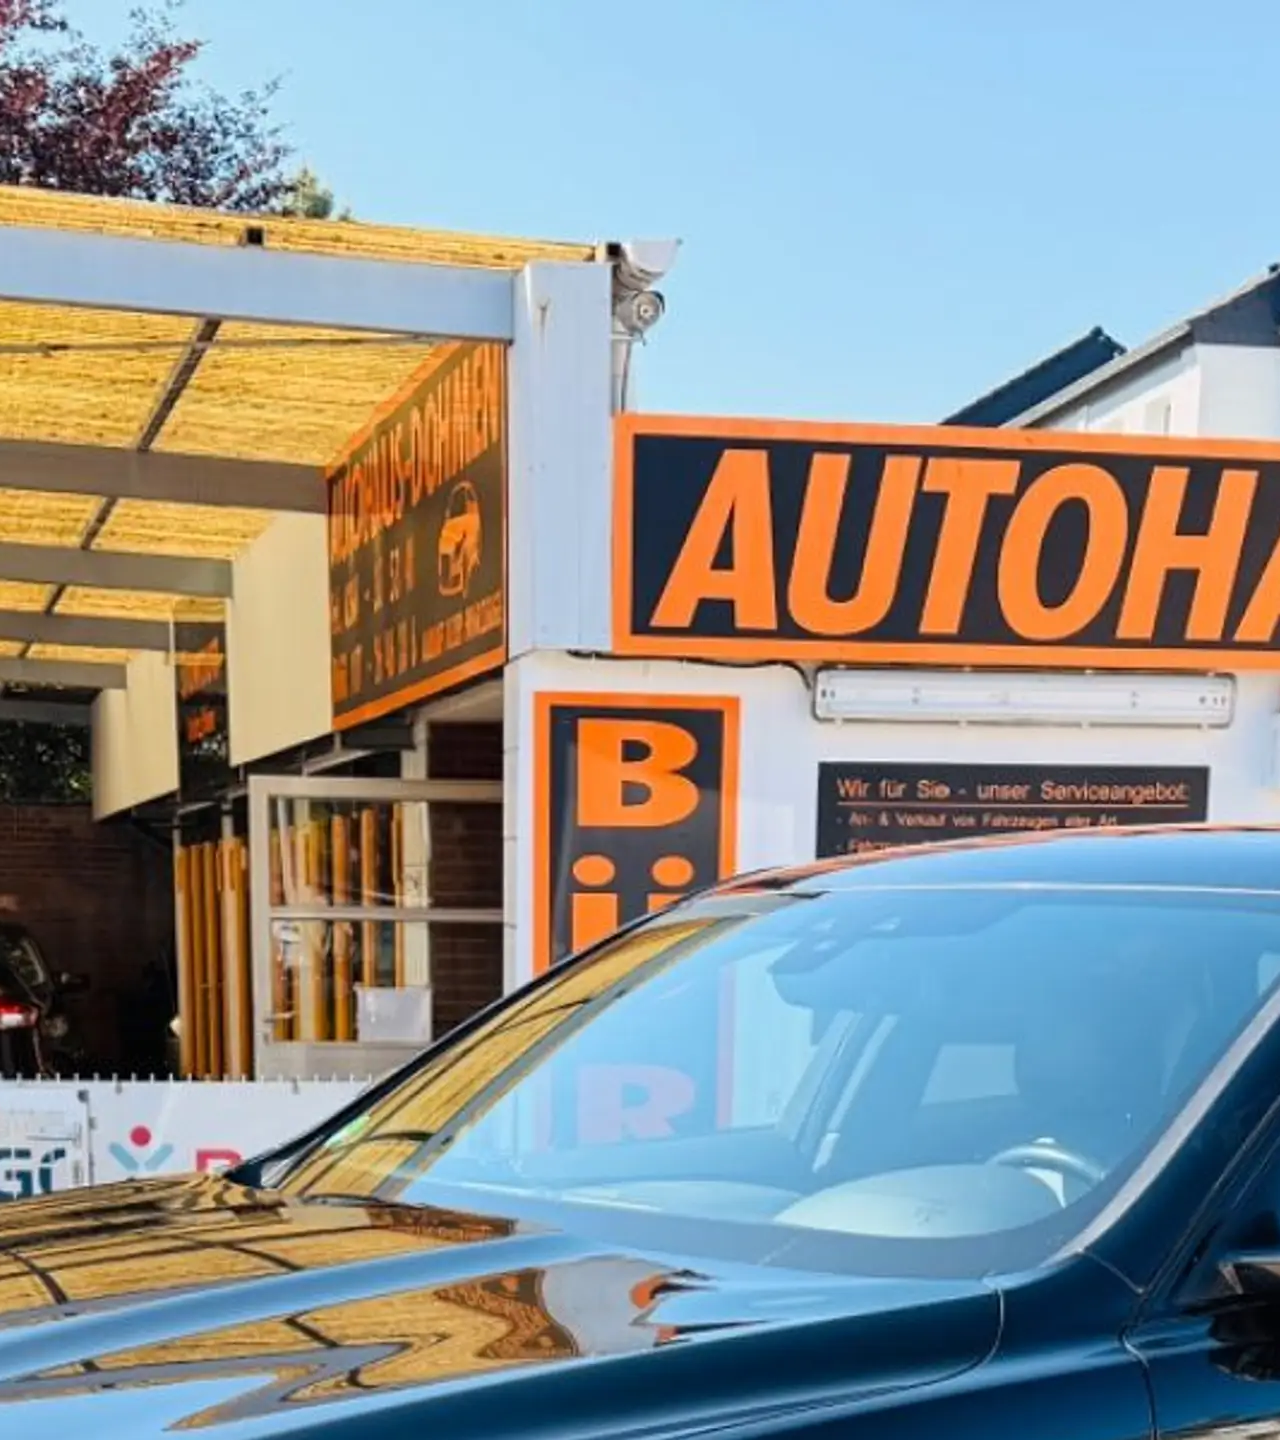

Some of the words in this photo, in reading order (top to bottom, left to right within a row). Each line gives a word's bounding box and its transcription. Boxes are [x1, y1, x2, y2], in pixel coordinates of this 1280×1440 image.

[837, 777, 871, 798] Wir
[880, 778, 907, 798] für
[916, 779, 951, 799] Sie
[977, 782, 1031, 799] unser
